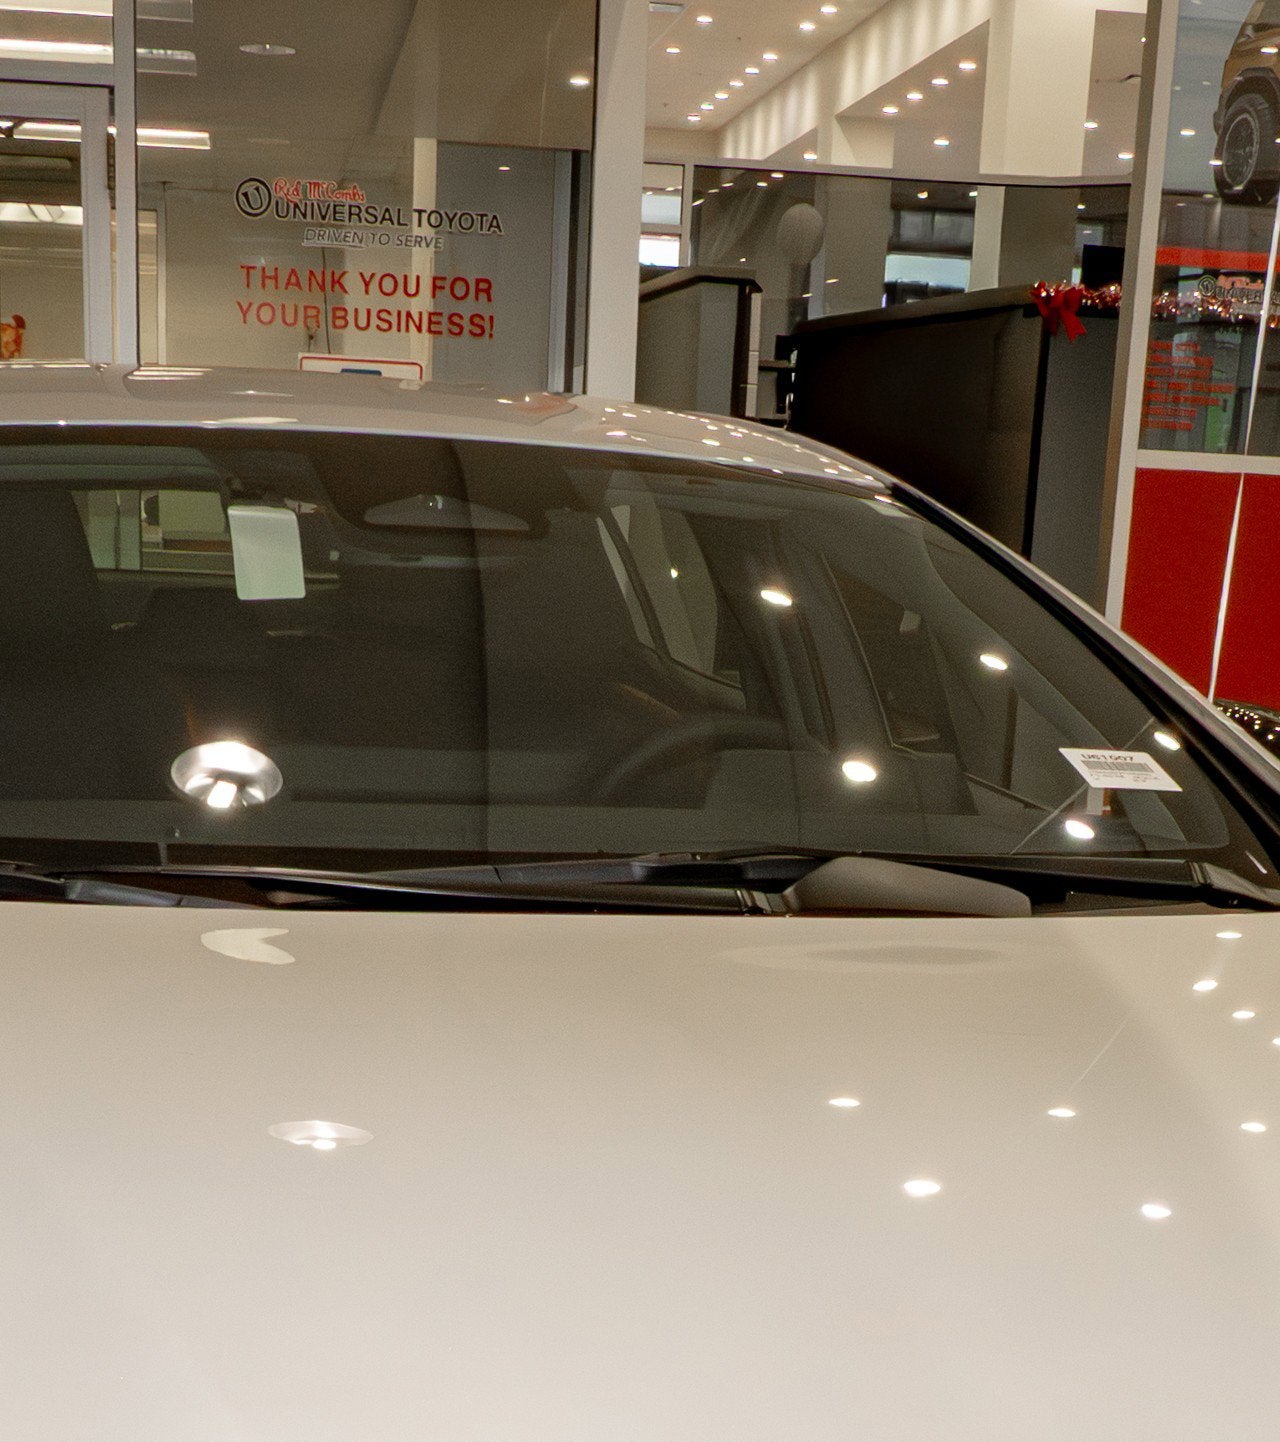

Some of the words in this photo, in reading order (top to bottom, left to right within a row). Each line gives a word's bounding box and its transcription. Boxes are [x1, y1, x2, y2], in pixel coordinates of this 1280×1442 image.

[274, 200, 409, 227] UNIVERSAL
[413, 208, 503, 233] TOYOTA
[304, 228, 365, 245] DRIVEN
[369, 232, 391, 246] TO
[395, 234, 444, 250] SERVE
[240, 264, 350, 295] THANK
[359, 272, 421, 298] YOU
[431, 276, 493, 303] FOR
[236, 300, 321, 329] YOUR
[331, 306, 495, 340] BUSINESS!
